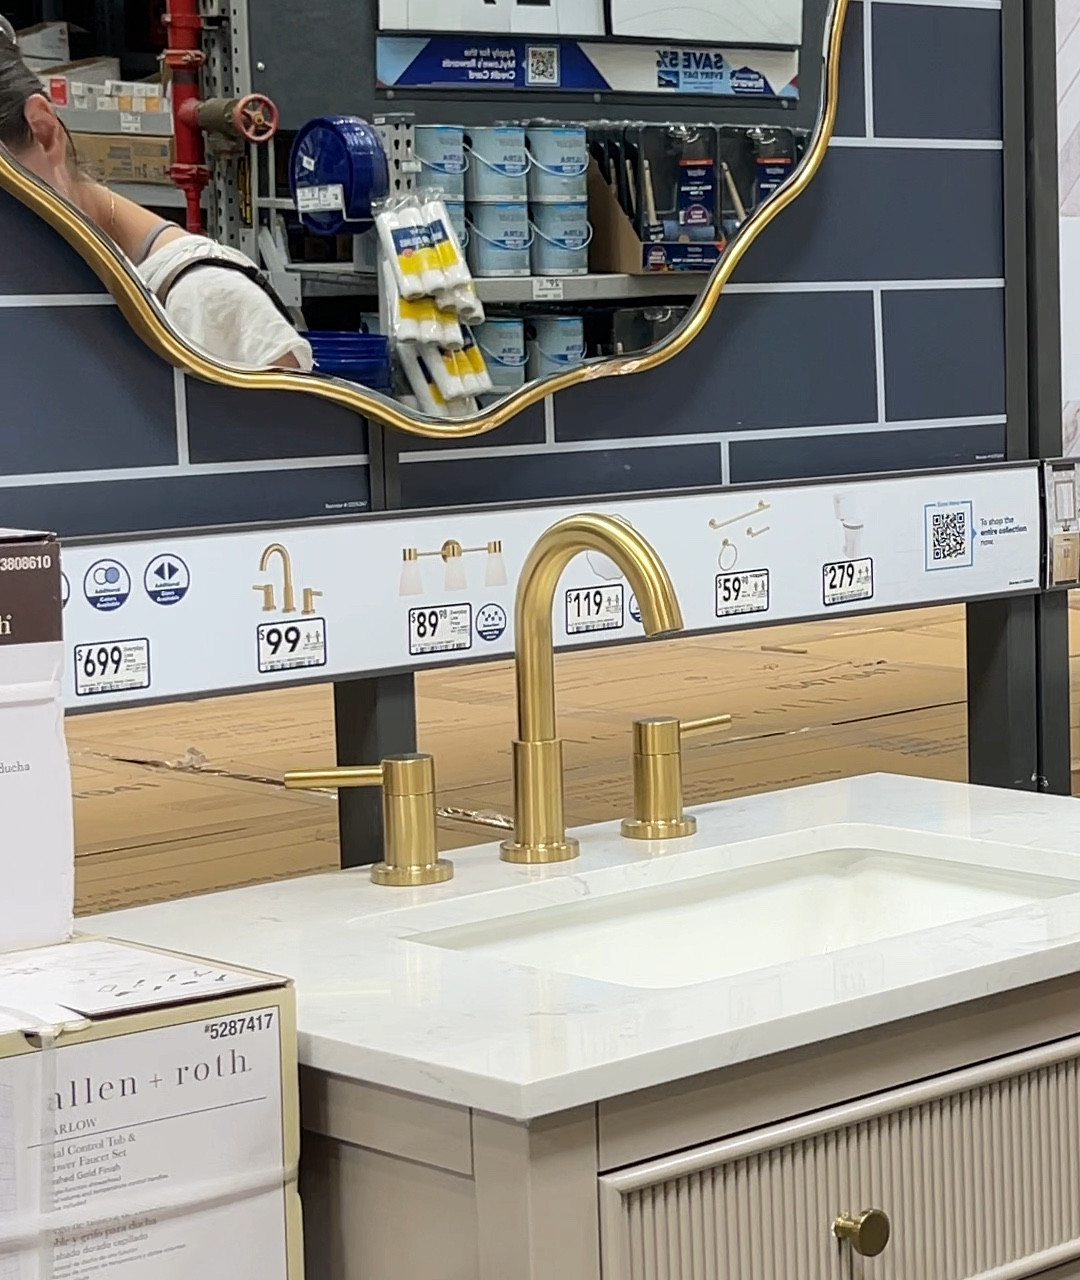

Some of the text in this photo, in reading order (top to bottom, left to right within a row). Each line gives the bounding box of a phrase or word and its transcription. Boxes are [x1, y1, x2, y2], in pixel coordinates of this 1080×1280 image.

[998, 526, 1027, 534] collection
[204, 1013, 274, 1040] #5287417
[46, 1049, 251, 1112] allen + roth
[67, 1132, 137, 1156] Control Tub &
[79, 1149, 127, 1167] Faucet Set
[77, 1168, 97, 1179] Gold
